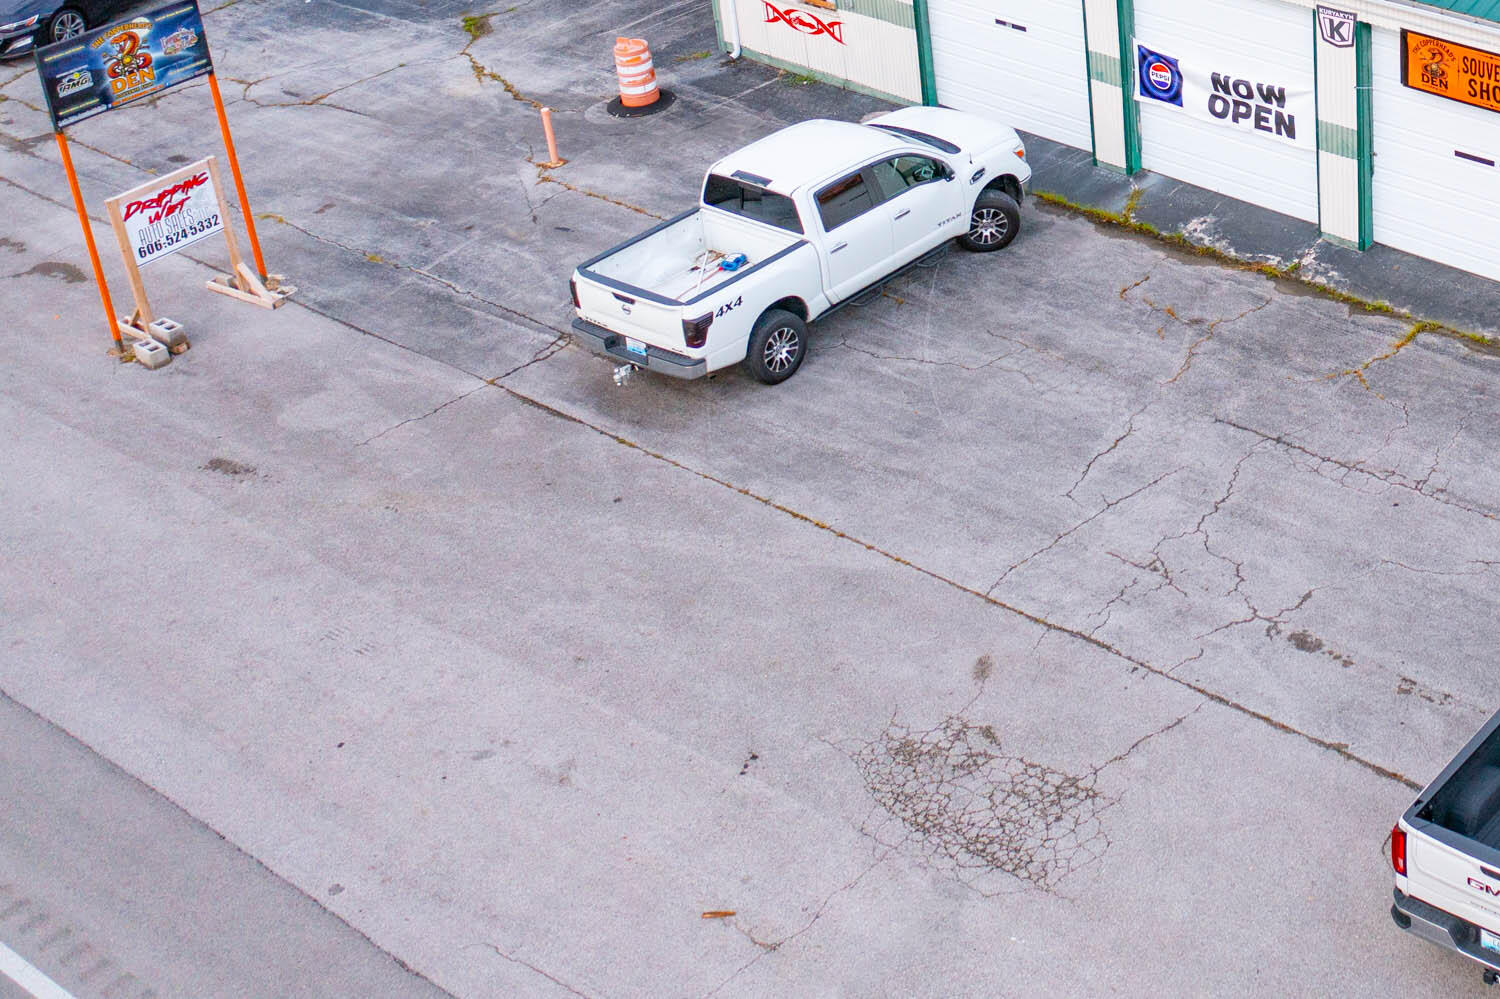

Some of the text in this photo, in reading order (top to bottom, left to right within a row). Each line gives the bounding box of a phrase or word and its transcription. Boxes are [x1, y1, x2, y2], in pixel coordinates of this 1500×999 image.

[90, 36, 104, 49] THE
[111, 65, 154, 96] DEN
[1151, 71, 1170, 82] PEPSI
[1210, 72, 1286, 109] NOW
[1421, 72, 1449, 91] DEN
[1207, 93, 1296, 140] OPEN
[123, 171, 209, 222] DRIPPING
[148, 196, 191, 225] WET
[138, 221, 164, 246] AUTO
[164, 208, 194, 235] SALES
